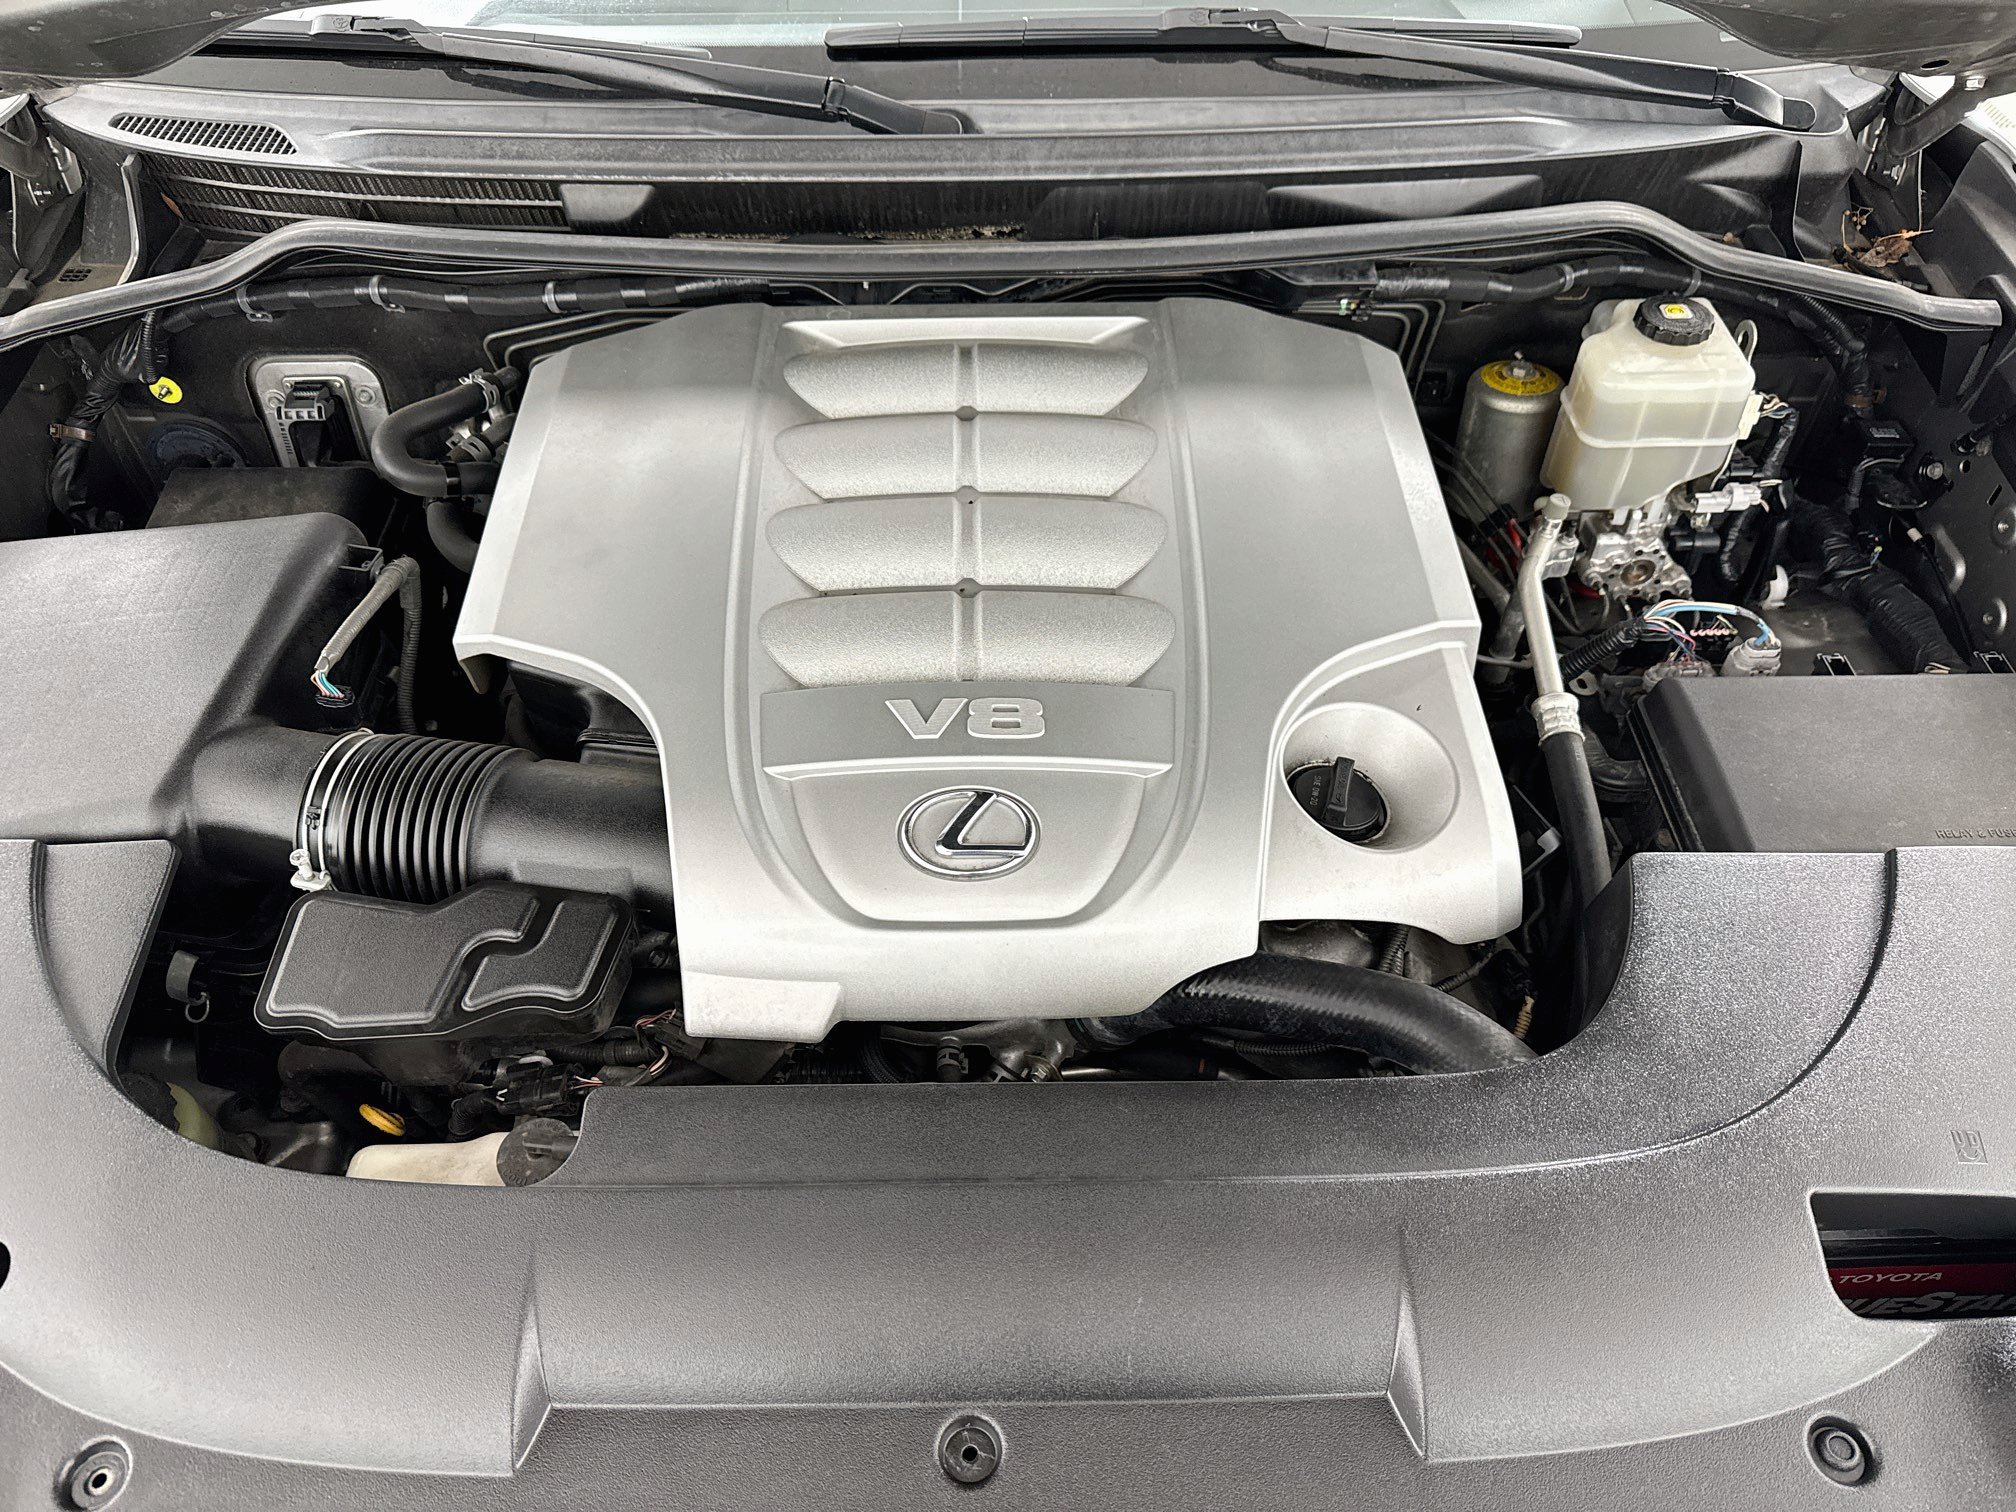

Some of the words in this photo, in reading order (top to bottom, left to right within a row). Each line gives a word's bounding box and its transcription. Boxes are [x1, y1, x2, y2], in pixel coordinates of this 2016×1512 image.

[885, 697, 1046, 740] V8
[1934, 828, 1974, 839] RELAY
[1977, 829, 1987, 839] &
[1839, 1272, 1943, 1284] TOYOTA
